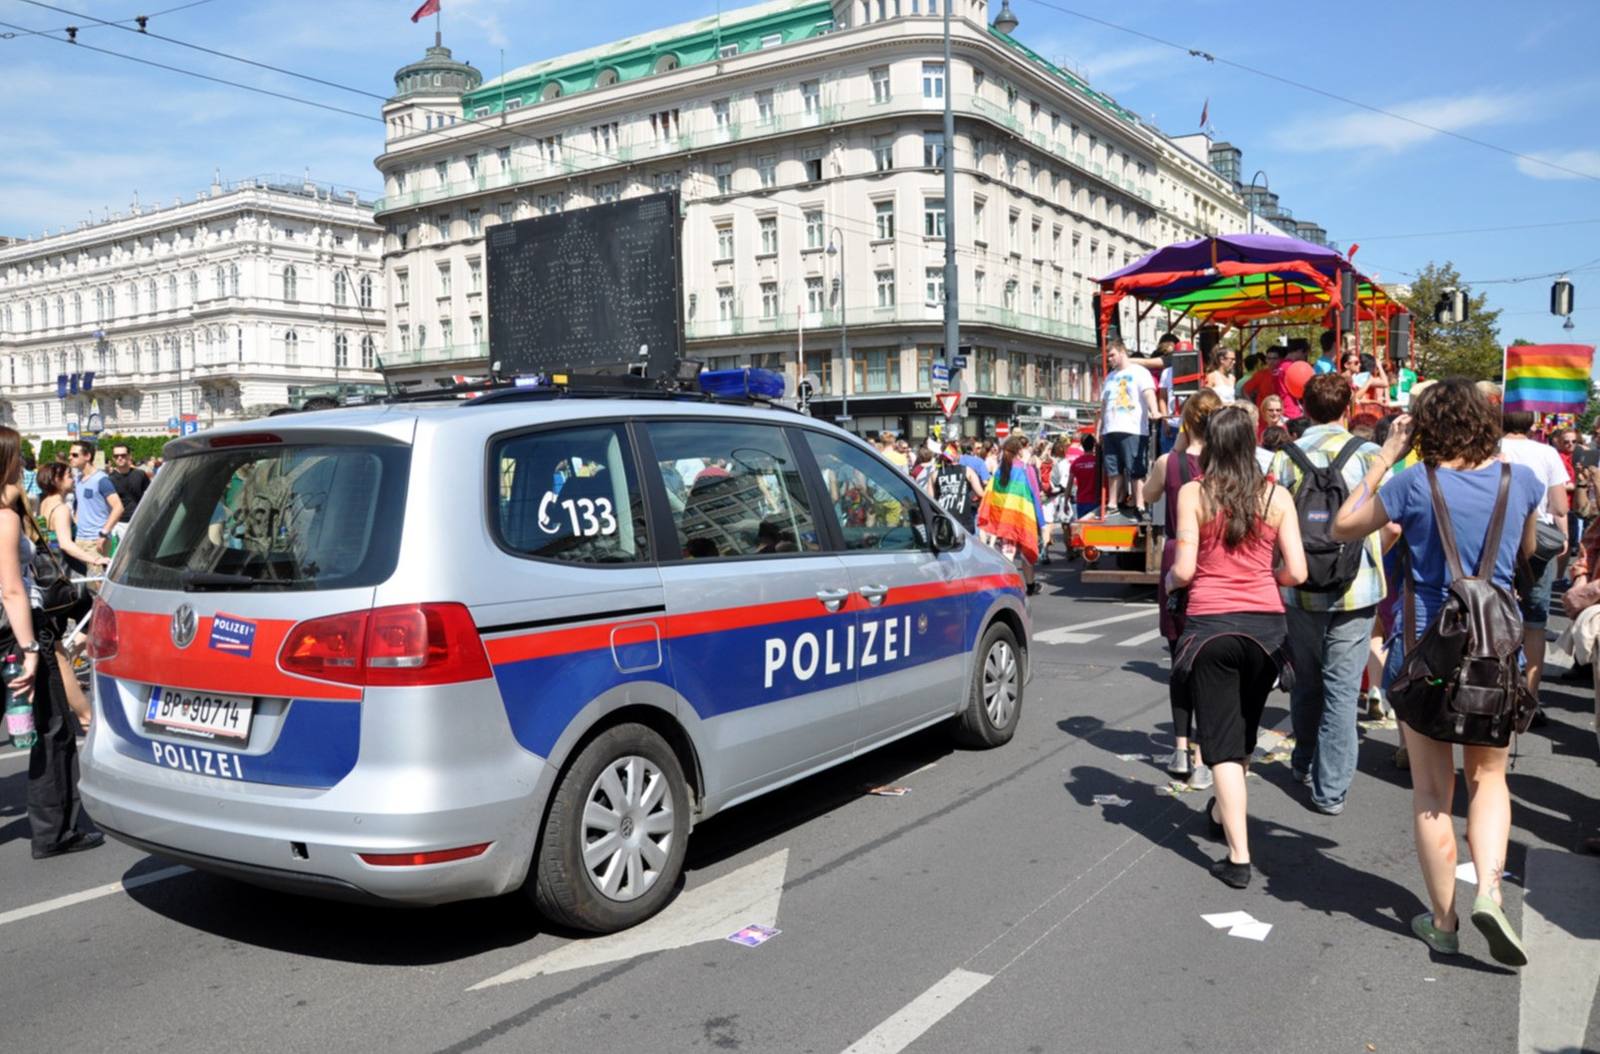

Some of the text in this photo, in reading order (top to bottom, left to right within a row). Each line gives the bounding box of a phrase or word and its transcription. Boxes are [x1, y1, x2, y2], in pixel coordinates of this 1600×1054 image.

[561, 497, 617, 537] 133
[213, 618, 250, 636] POLIZEI
[764, 615, 912, 689] POLIZEI
[190, 695, 239, 729] 90714
[151, 741, 244, 779] POLIZEI
